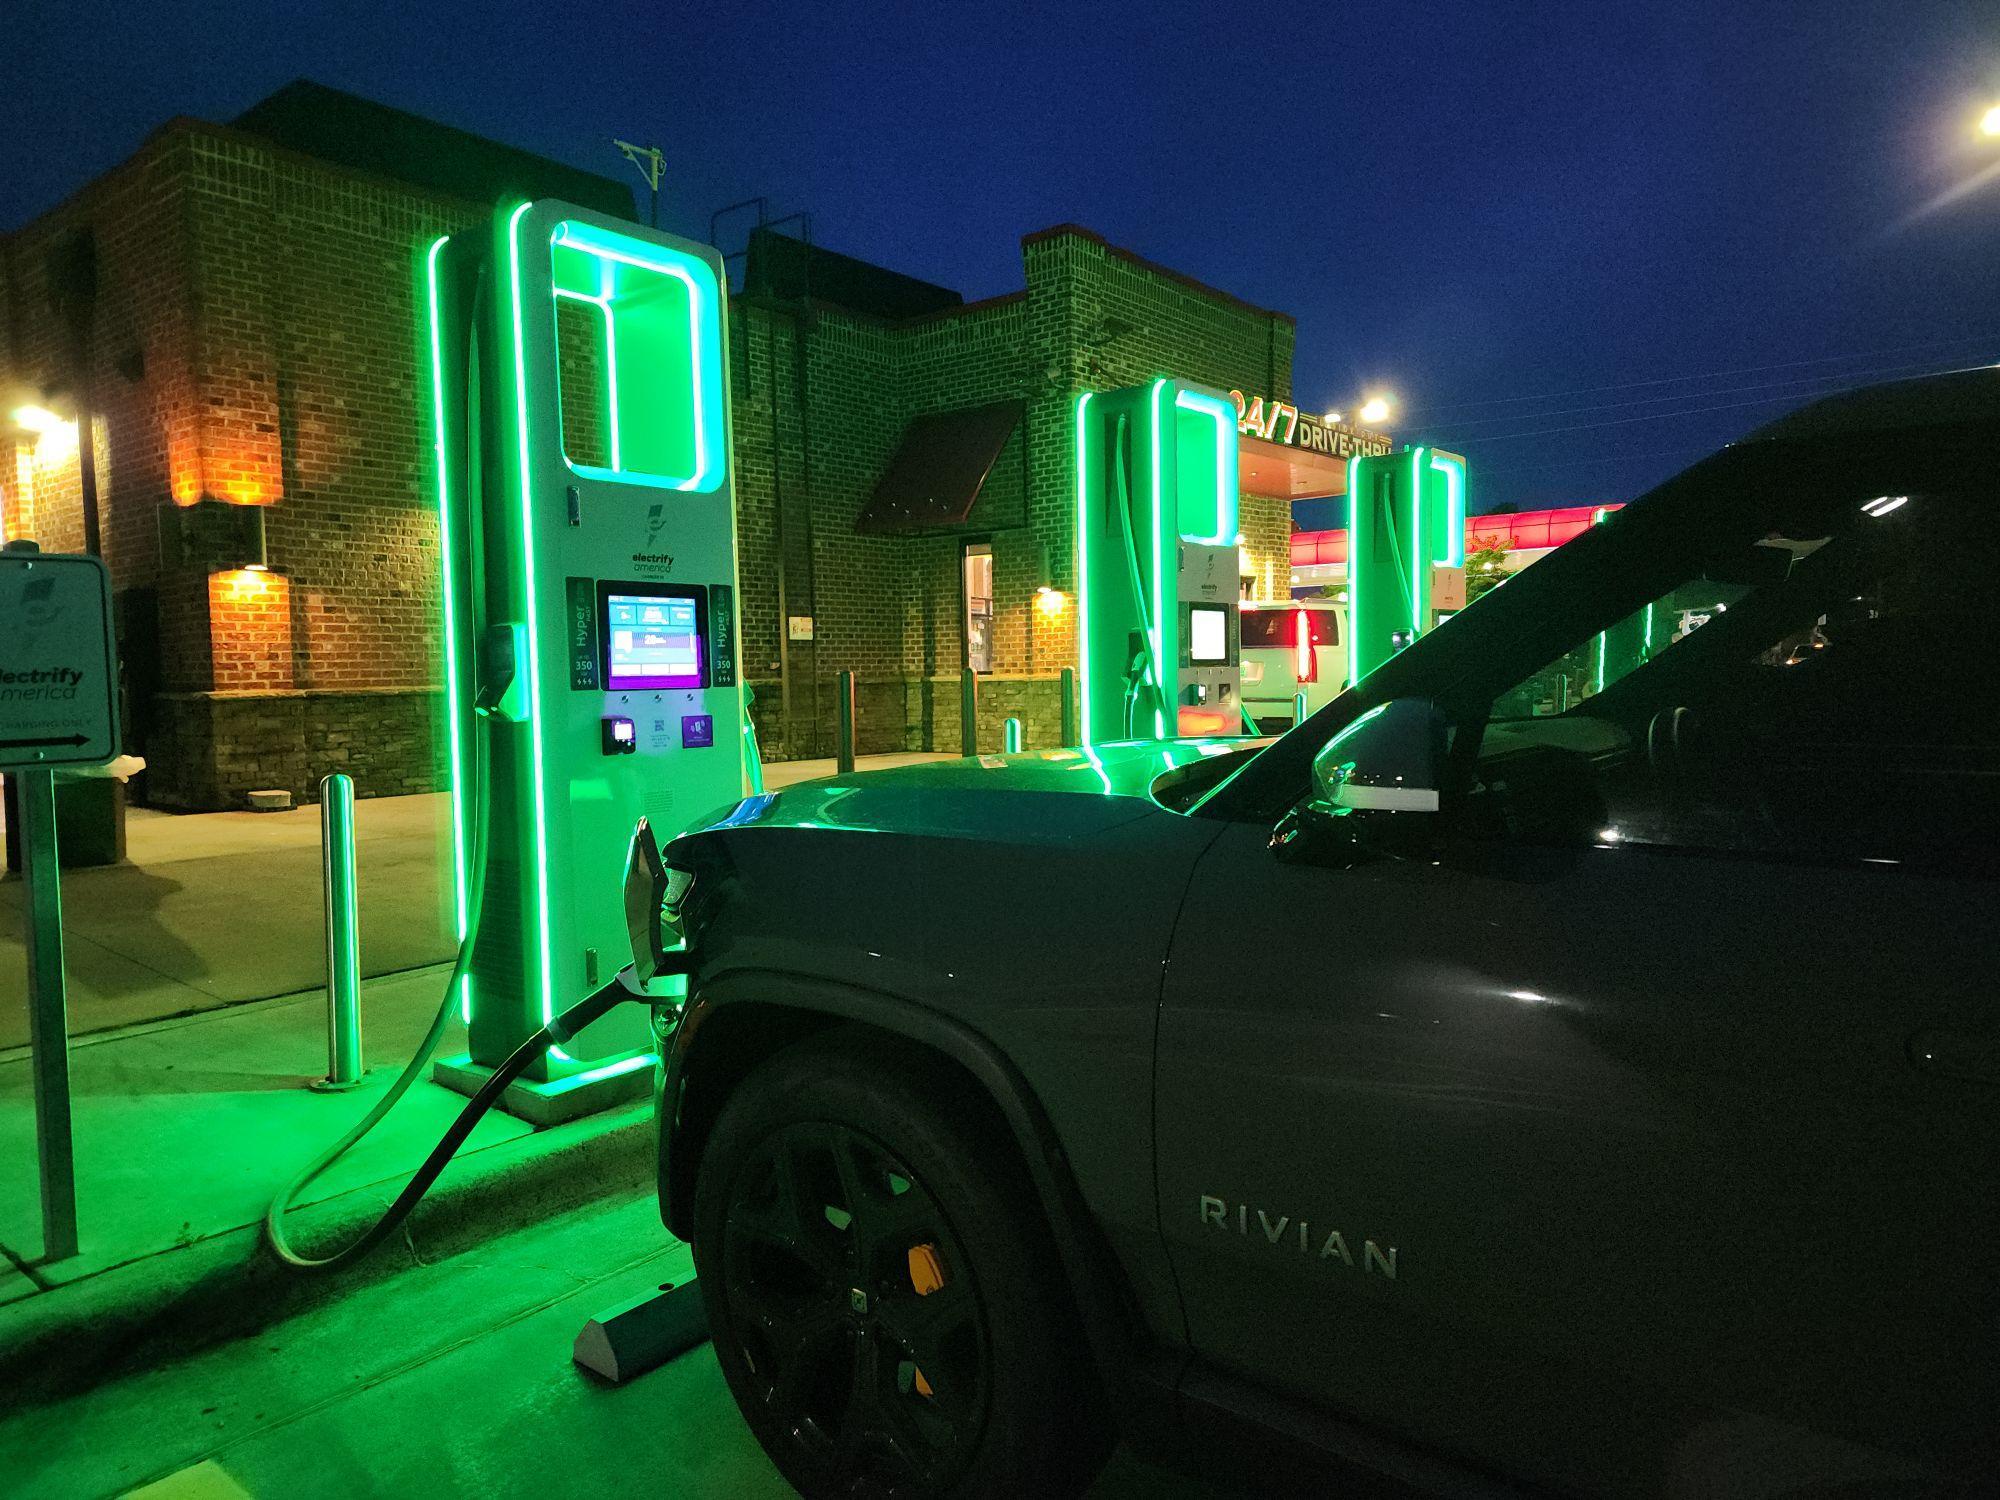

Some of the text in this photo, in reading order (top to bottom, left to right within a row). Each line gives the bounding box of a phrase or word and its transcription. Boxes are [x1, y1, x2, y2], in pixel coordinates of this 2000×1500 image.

[1229, 389, 1298, 444] 24/7
[632, 553, 675, 565] electrify
[633, 564, 672, 573] america
[576, 606, 588, 647] Hyper
[717, 610, 728, 648] Hyper
[575, 660, 593, 670] 350
[716, 660, 731, 669] 350
[0, 667, 83, 686] lectrify
[0, 685, 77, 700] merica
[1200, 1195, 1397, 1279] RIVIAN
